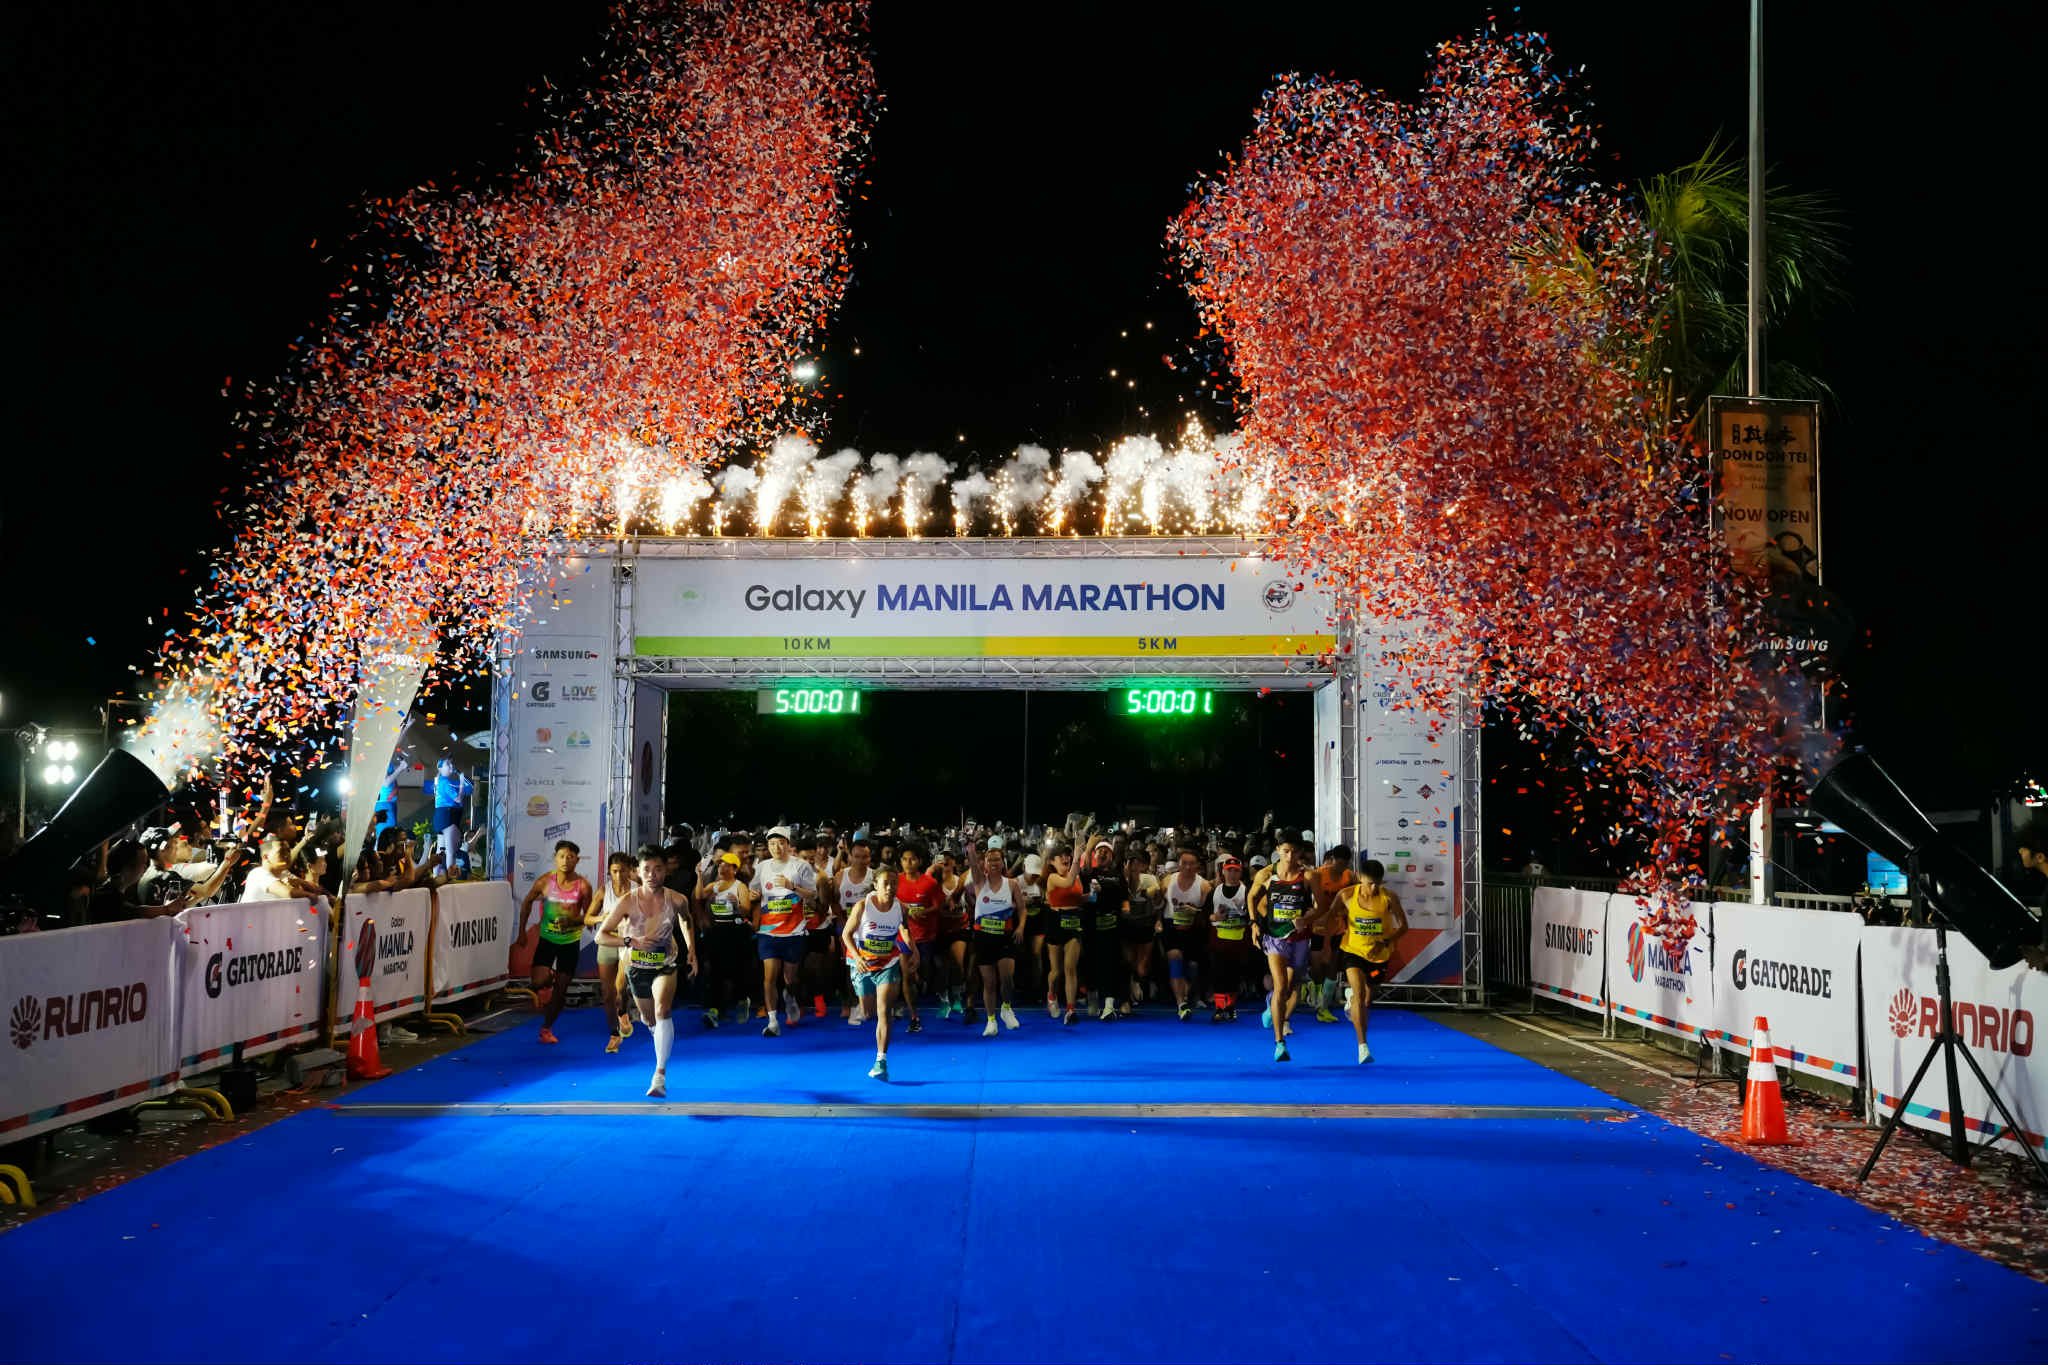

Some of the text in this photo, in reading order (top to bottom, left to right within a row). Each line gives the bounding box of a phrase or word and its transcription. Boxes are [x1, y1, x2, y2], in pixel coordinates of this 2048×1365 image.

[1722, 449, 1752, 461] DON
[1787, 451, 1807, 464] TEI
[1722, 507, 1809, 524] NOW OPEN
[744, 584, 1225, 618] Galaxy MANILA MARATHON
[535, 649, 592, 660] SAMSUNG
[561, 685, 597, 698] LOVE
[776, 690, 858, 713] 5:00:01
[1127, 690, 1212, 713] 5:00:01
[378, 930, 414, 960] MANILA
[1545, 922, 1593, 957] SAMSUNG
[227, 946, 304, 987] GATORADE
[1750, 958, 1832, 999] GATORADE
[44, 982, 147, 1040] RUNRIO
